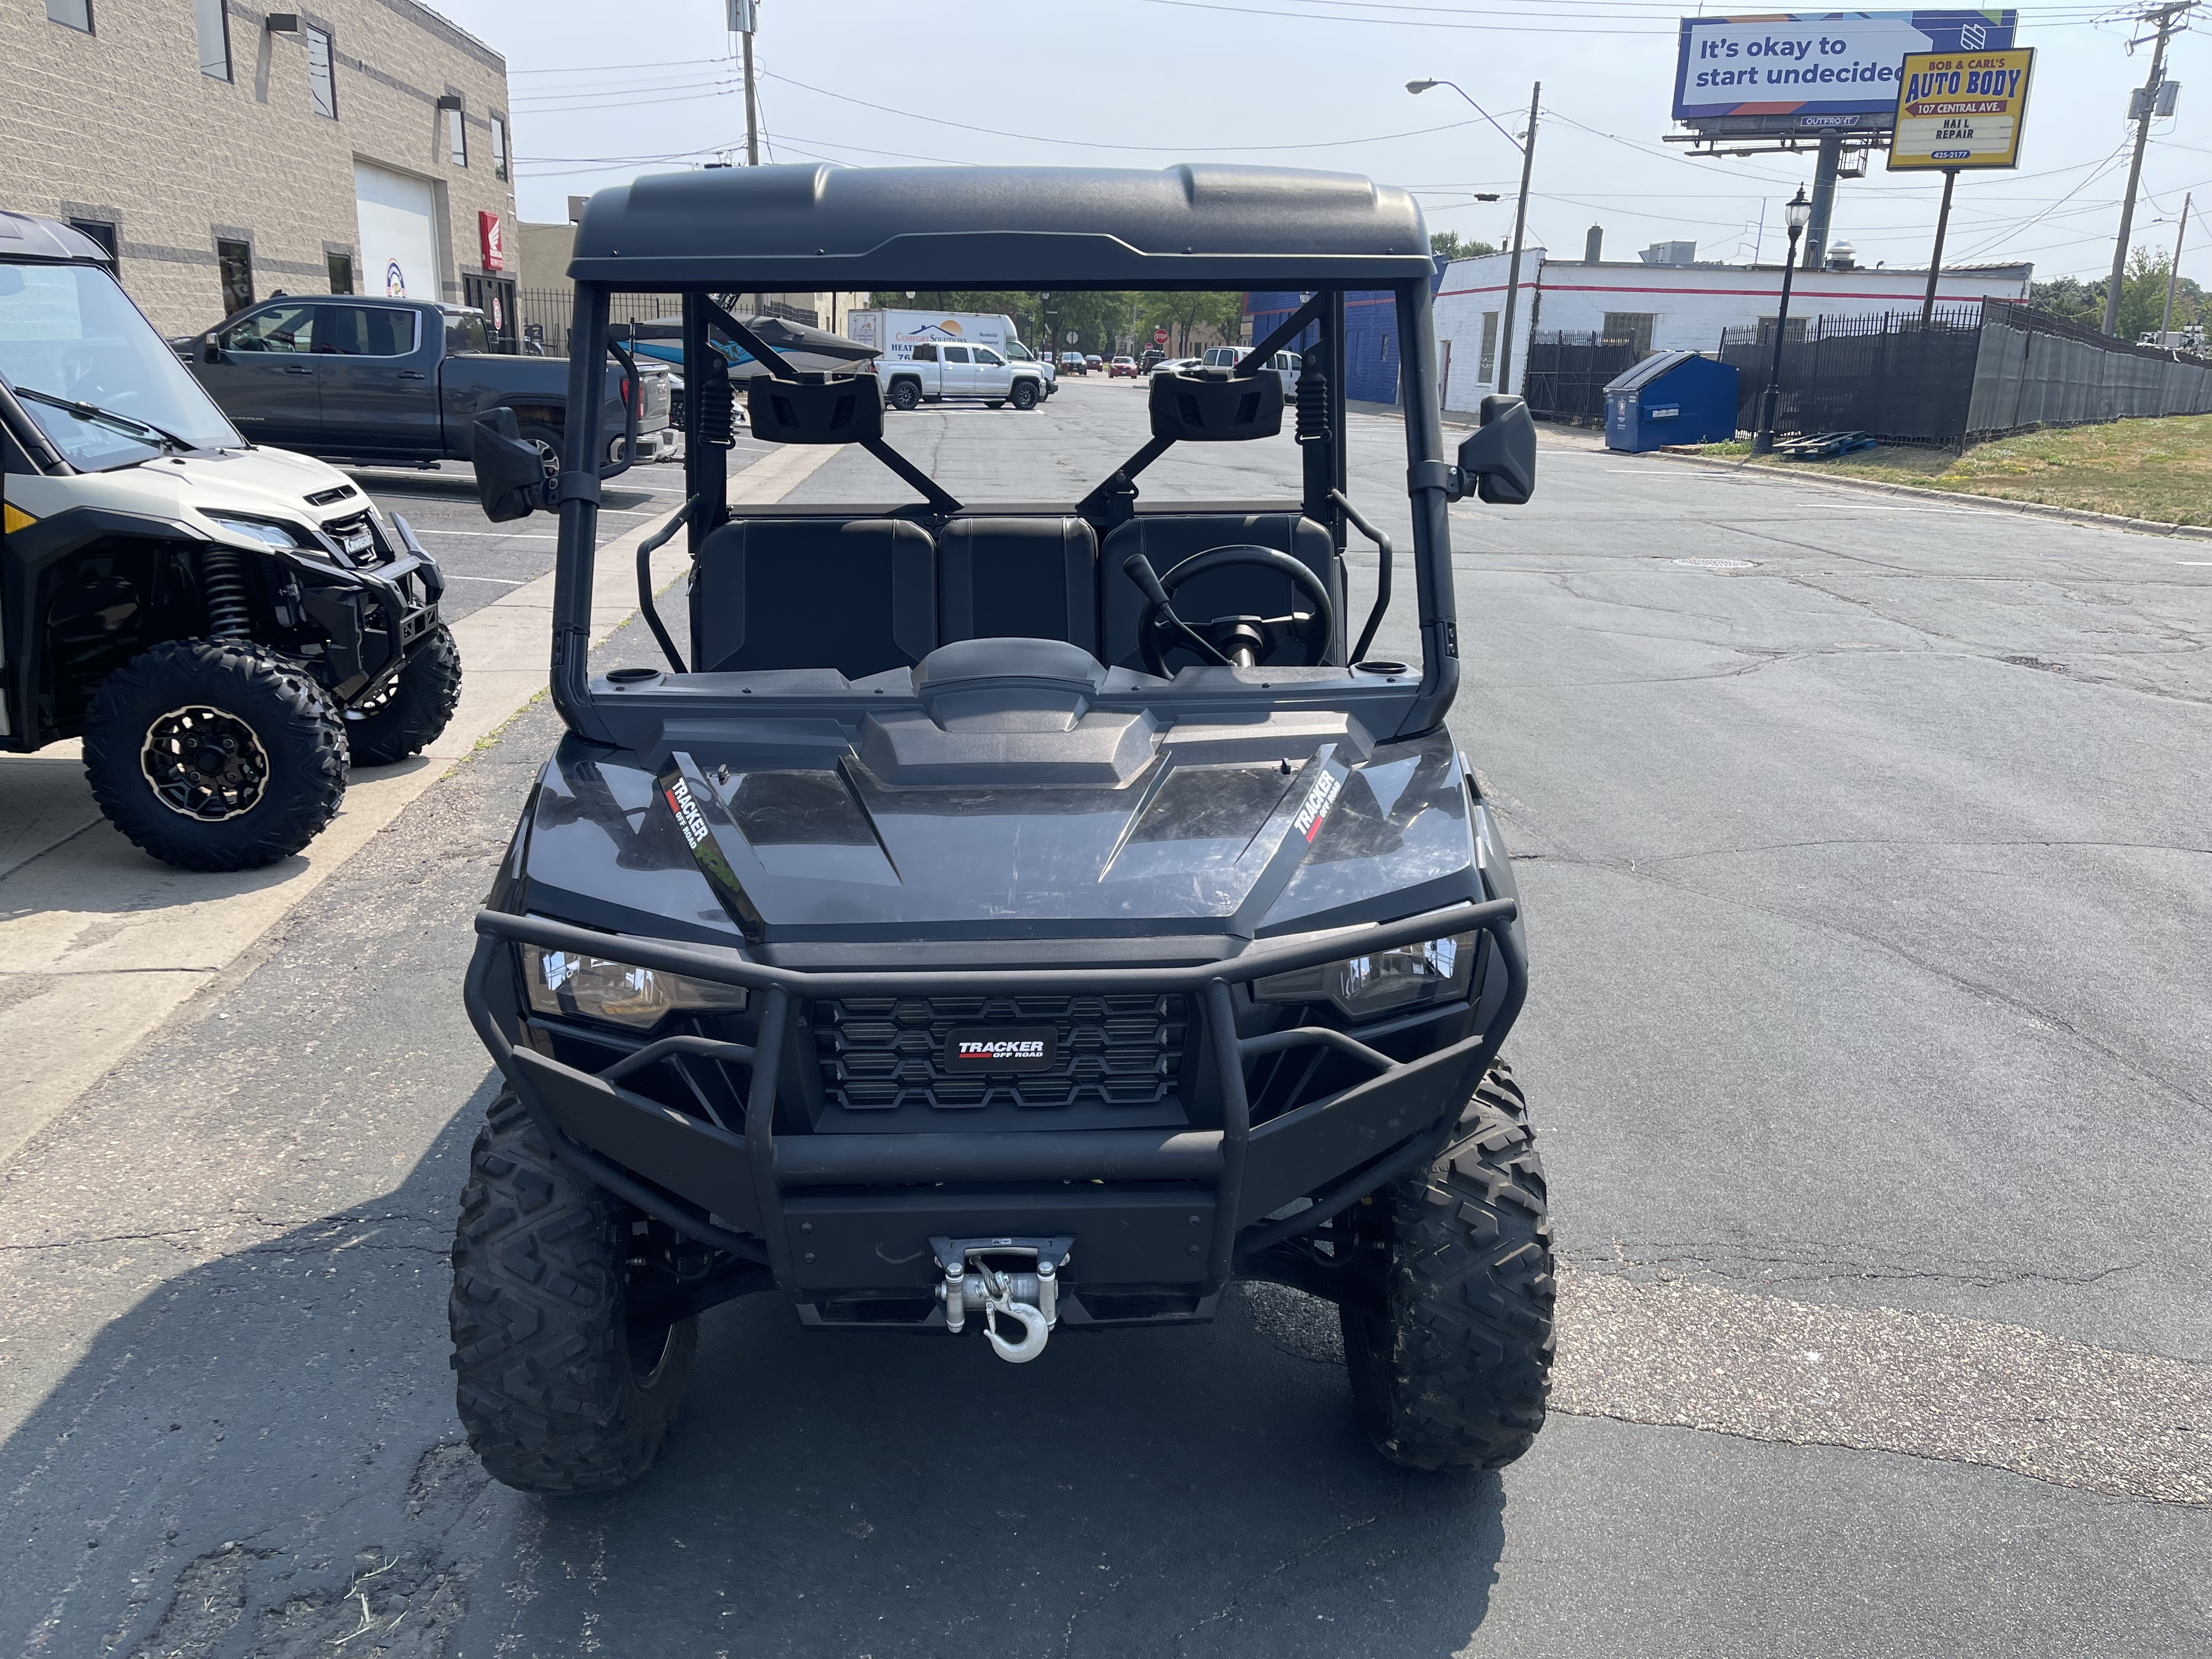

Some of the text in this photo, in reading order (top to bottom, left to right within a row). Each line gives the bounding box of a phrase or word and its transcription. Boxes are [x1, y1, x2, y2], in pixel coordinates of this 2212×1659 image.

[1701, 36, 1846, 60] It's okay to
[1696, 66, 1758, 87] start
[1929, 59, 2005, 70] BOB & CARL'S
[1905, 69, 2022, 104] AUTO BODY
[1918, 102, 2000, 114] 107 CENTRAL AVE.
[1936, 129, 1974, 139] REPAIR
[895, 332, 930, 342] COMFORT
[343, 530, 374, 554] Kawasaki
[672, 777, 708, 842] TRACKER
[1294, 770, 1335, 836] TRACKER
[1319, 781, 1341, 818] OFF ROAD
[675, 811, 697, 850] OFF ROAD
[959, 1041, 1043, 1053] TRACKER
